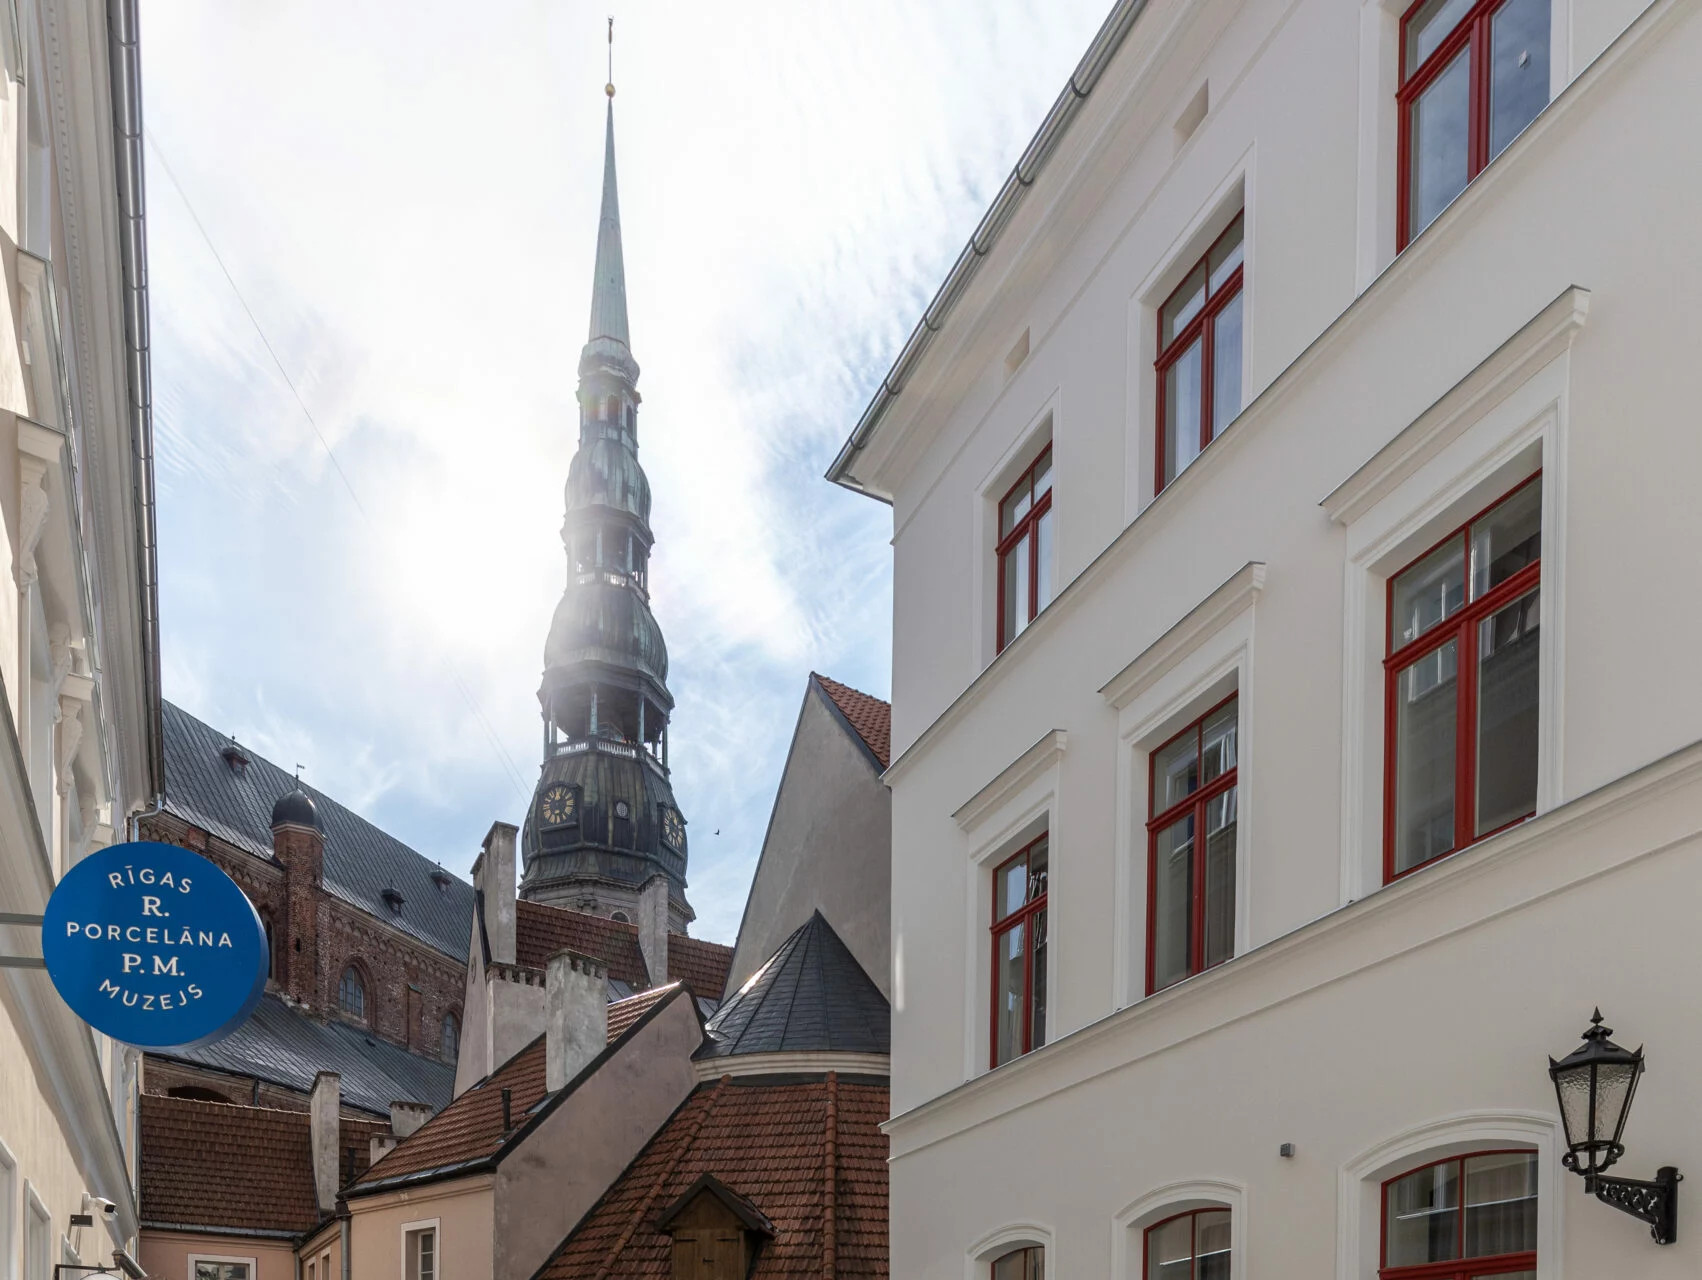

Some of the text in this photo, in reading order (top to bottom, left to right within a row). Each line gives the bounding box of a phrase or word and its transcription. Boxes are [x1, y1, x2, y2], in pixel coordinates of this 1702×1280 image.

[109, 866, 192, 893] RĪGAS
[142, 896, 169, 916] R.
[67, 922, 232, 947] PORCELĀNA
[99, 979, 202, 1010] MUZEJS
